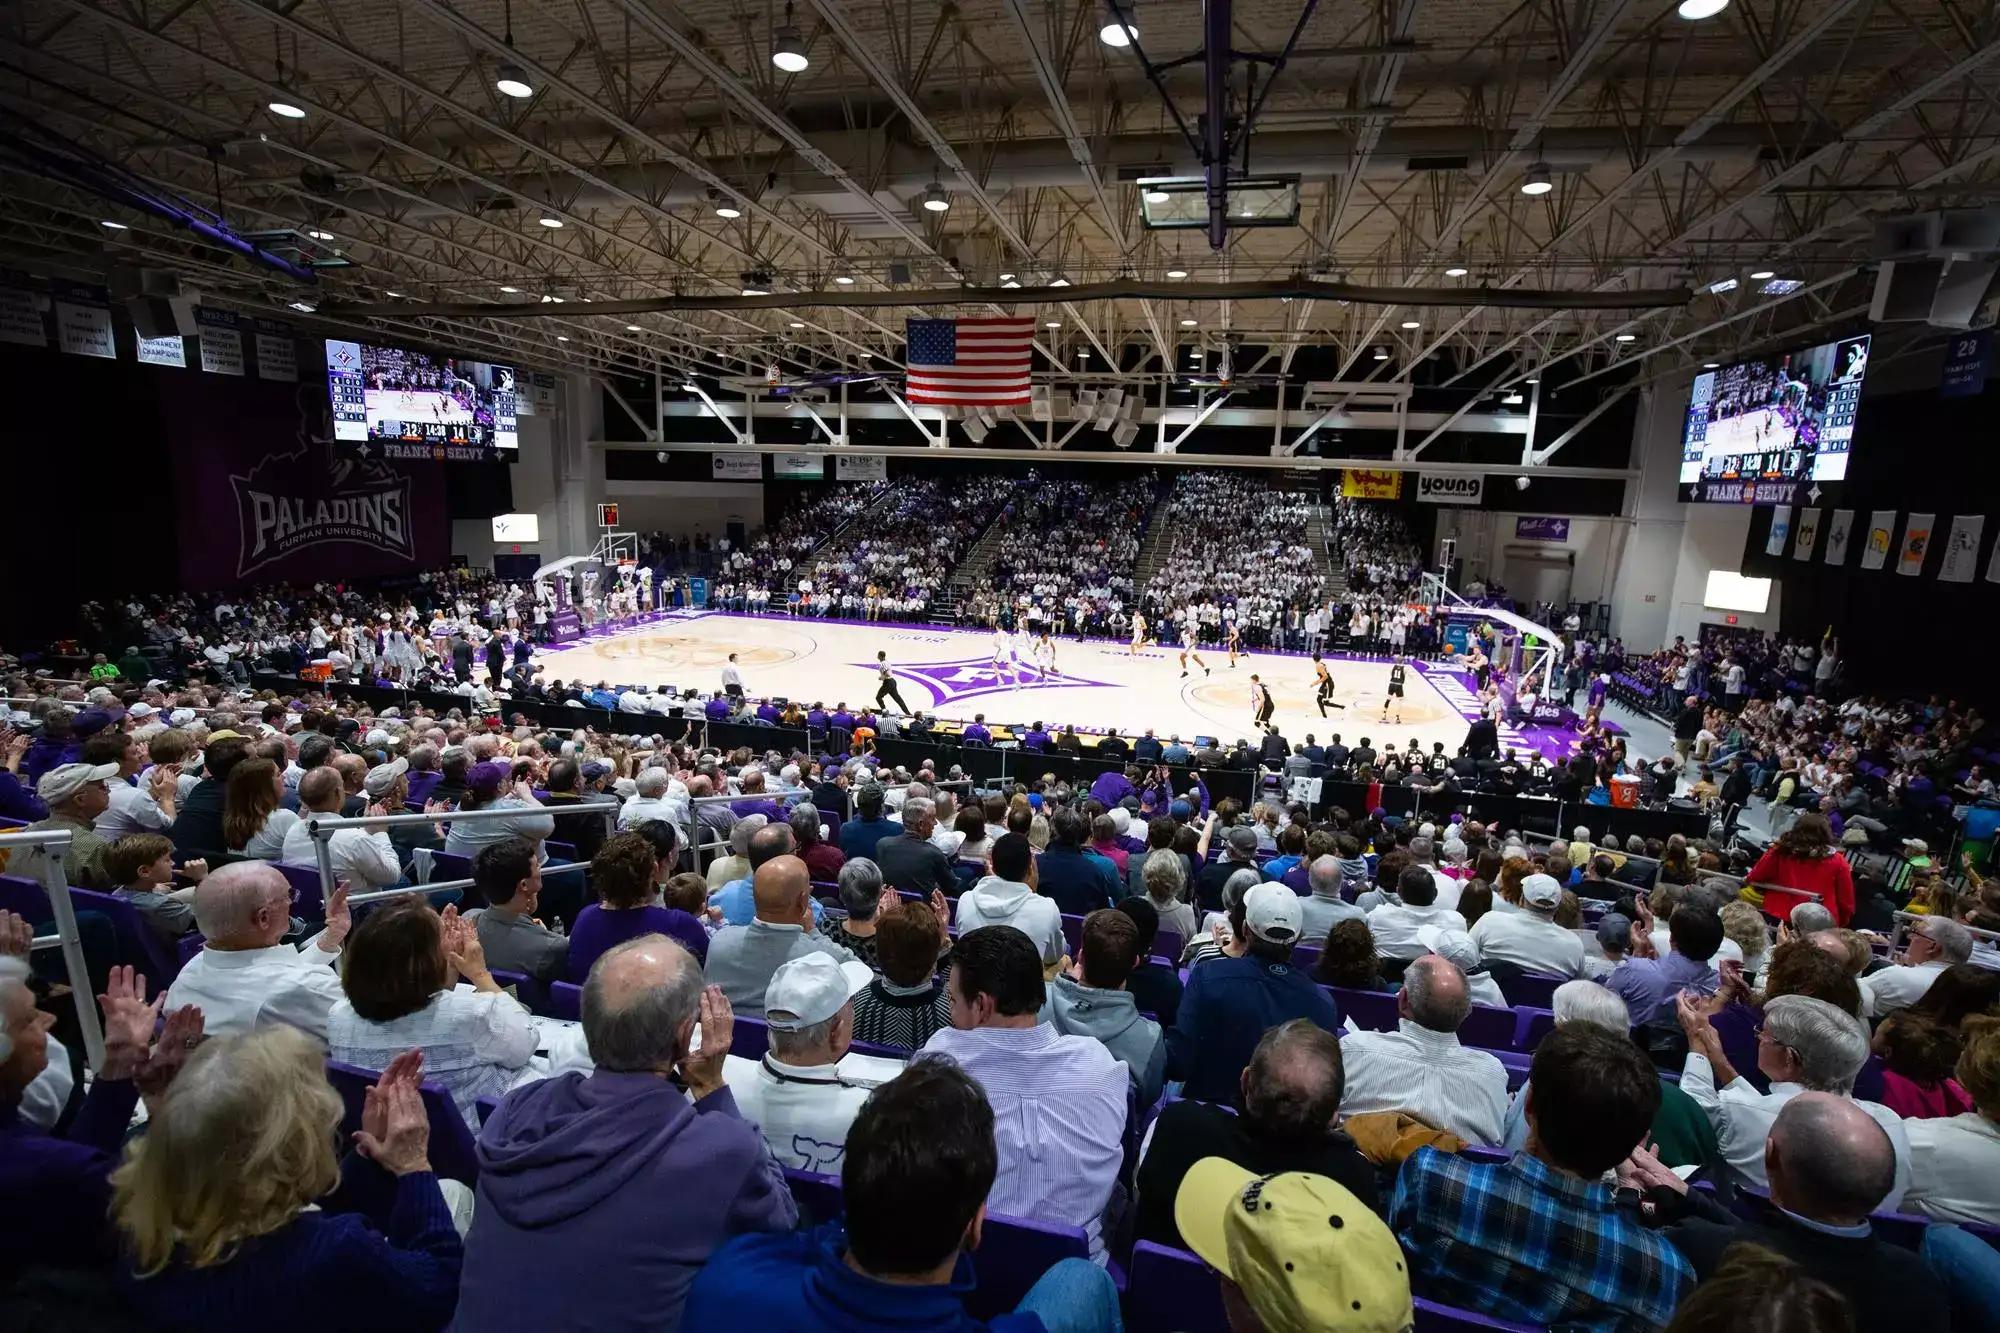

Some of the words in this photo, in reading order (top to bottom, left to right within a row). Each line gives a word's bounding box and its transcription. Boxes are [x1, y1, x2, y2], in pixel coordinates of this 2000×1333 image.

[1956, 339, 1978, 358] 28
[334, 402, 345, 411] 32
[405, 422, 417, 437] 12
[453, 426, 464, 440] 14
[384, 444, 431, 458] FRANK
[433, 448, 444, 457] 100
[446, 447, 485, 460] SELVY
[1768, 453, 1780, 472] 14
[1421, 477, 1480, 498] young
[1705, 484, 1743, 500] FRANK
[1756, 483, 1797, 502] SELVY
[247, 489, 405, 558] PALADINS
[279, 529, 322, 551] FURMAN
[326, 527, 383, 543] UNIVERSITY
[1408, 753, 1423, 764] 33
[1433, 759, 1446, 769] 21
[1532, 766, 1545, 777] 12
